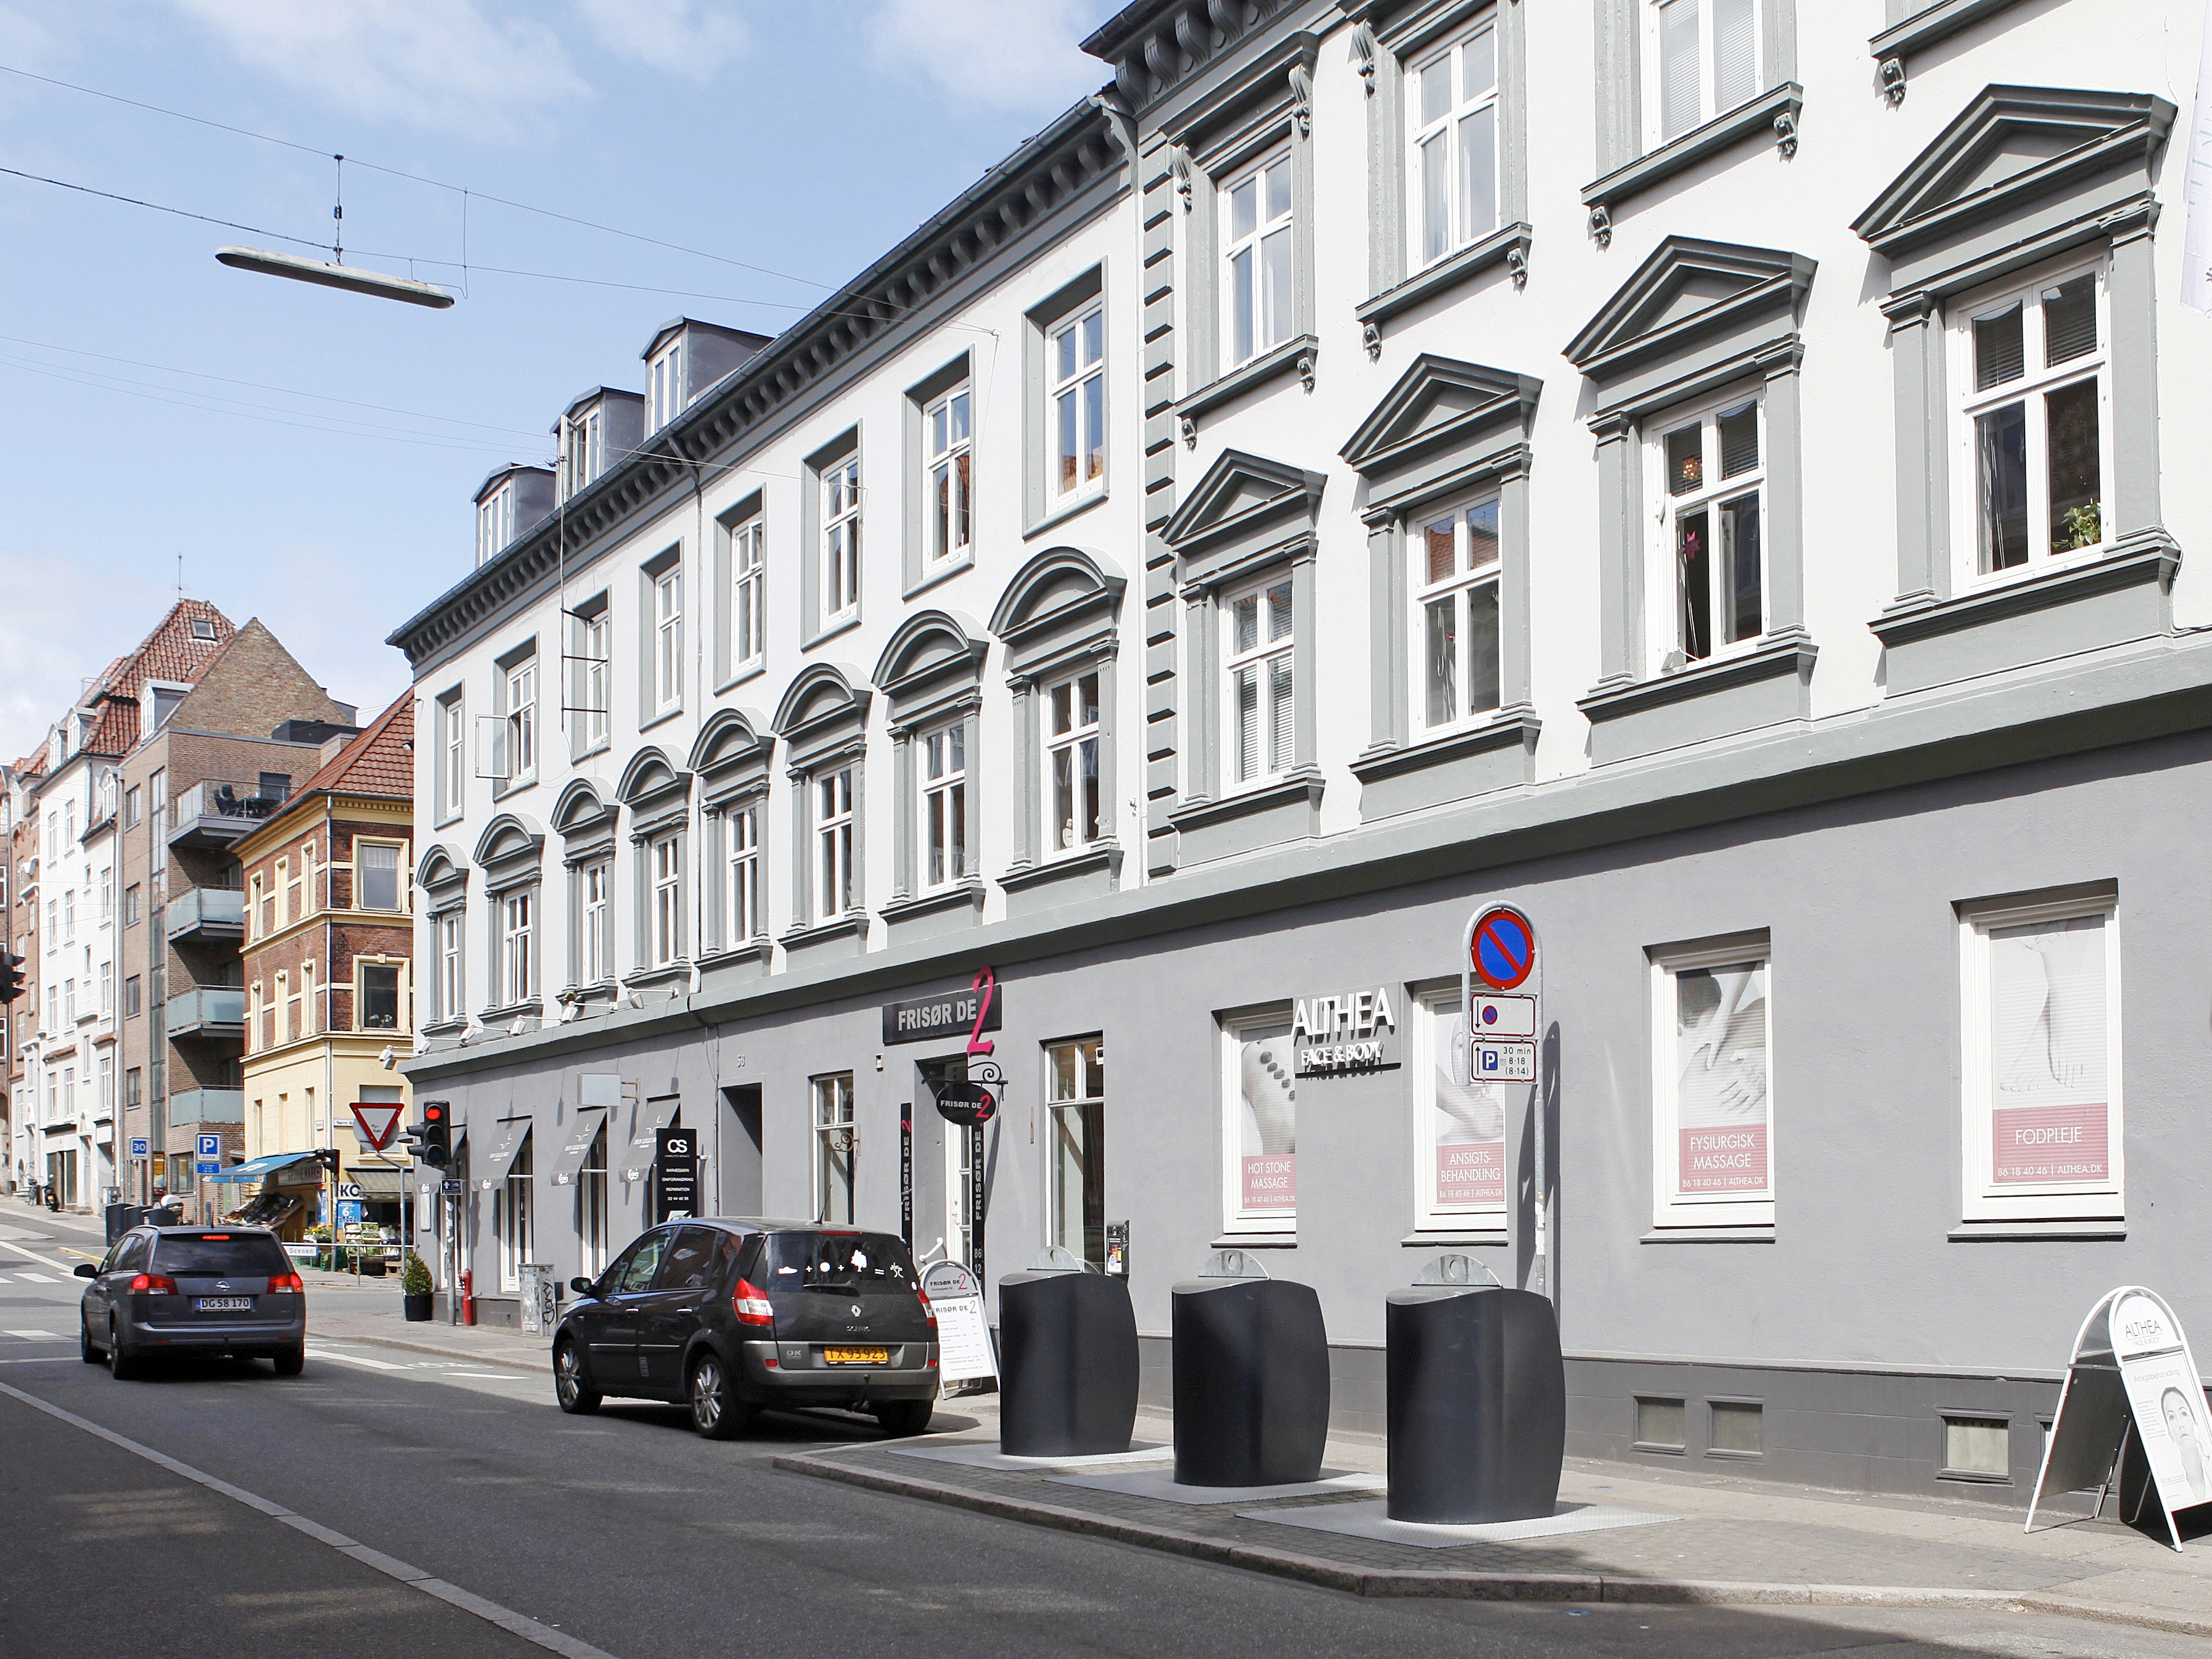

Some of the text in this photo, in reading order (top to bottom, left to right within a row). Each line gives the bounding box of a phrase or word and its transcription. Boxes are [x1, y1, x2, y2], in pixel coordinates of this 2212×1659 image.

[898, 964, 994, 1054] FRISØR DE 2
[1290, 987, 1395, 1038] ALTHEA
[1301, 1040, 1382, 1066] FACE & BODY
[1486, 1052, 1496, 1069] P
[1509, 1057, 1525, 1065] 8-18
[1505, 1067, 1529, 1075] (8-14)
[940, 1100, 969, 1108] FRISØR
[975, 1094, 991, 1118] 2
[901, 1120, 911, 1133] 2
[975, 1131, 981, 1153] DE
[1690, 1133, 1755, 1150] FYSIURGISK
[2015, 1126, 2083, 1145] FODPLEJE
[133, 1143, 146, 1151] 30
[202, 1138, 215, 1153] P
[667, 1139, 688, 1153] CS
[904, 1136, 909, 1157] DE
[1449, 1151, 1492, 1165] ANSIGTS-
[1694, 1153, 1751, 1169] MASSAGE
[1248, 1161, 1291, 1174] HOT STONE
[1997, 1163, 2103, 1176] 86 18 40 46 ALTHEA.DK
[1441, 1168, 1501, 1182] BEHANDLING
[1682, 1176, 1764, 1187] 86 18 40 46 ALTHEA.DK
[1251, 1176, 1288, 1189] MASSAGE
[974, 1248, 982, 1258] 86
[975, 1263, 981, 1274] 12
[957, 1273, 968, 1290] 2
[202, 1298, 249, 1308] DG 58 170
[970, 1300, 977, 1313] 2
[2126, 1320, 2163, 1338] ALTHEA
[827, 1348, 885, 1359] TX 93 923
